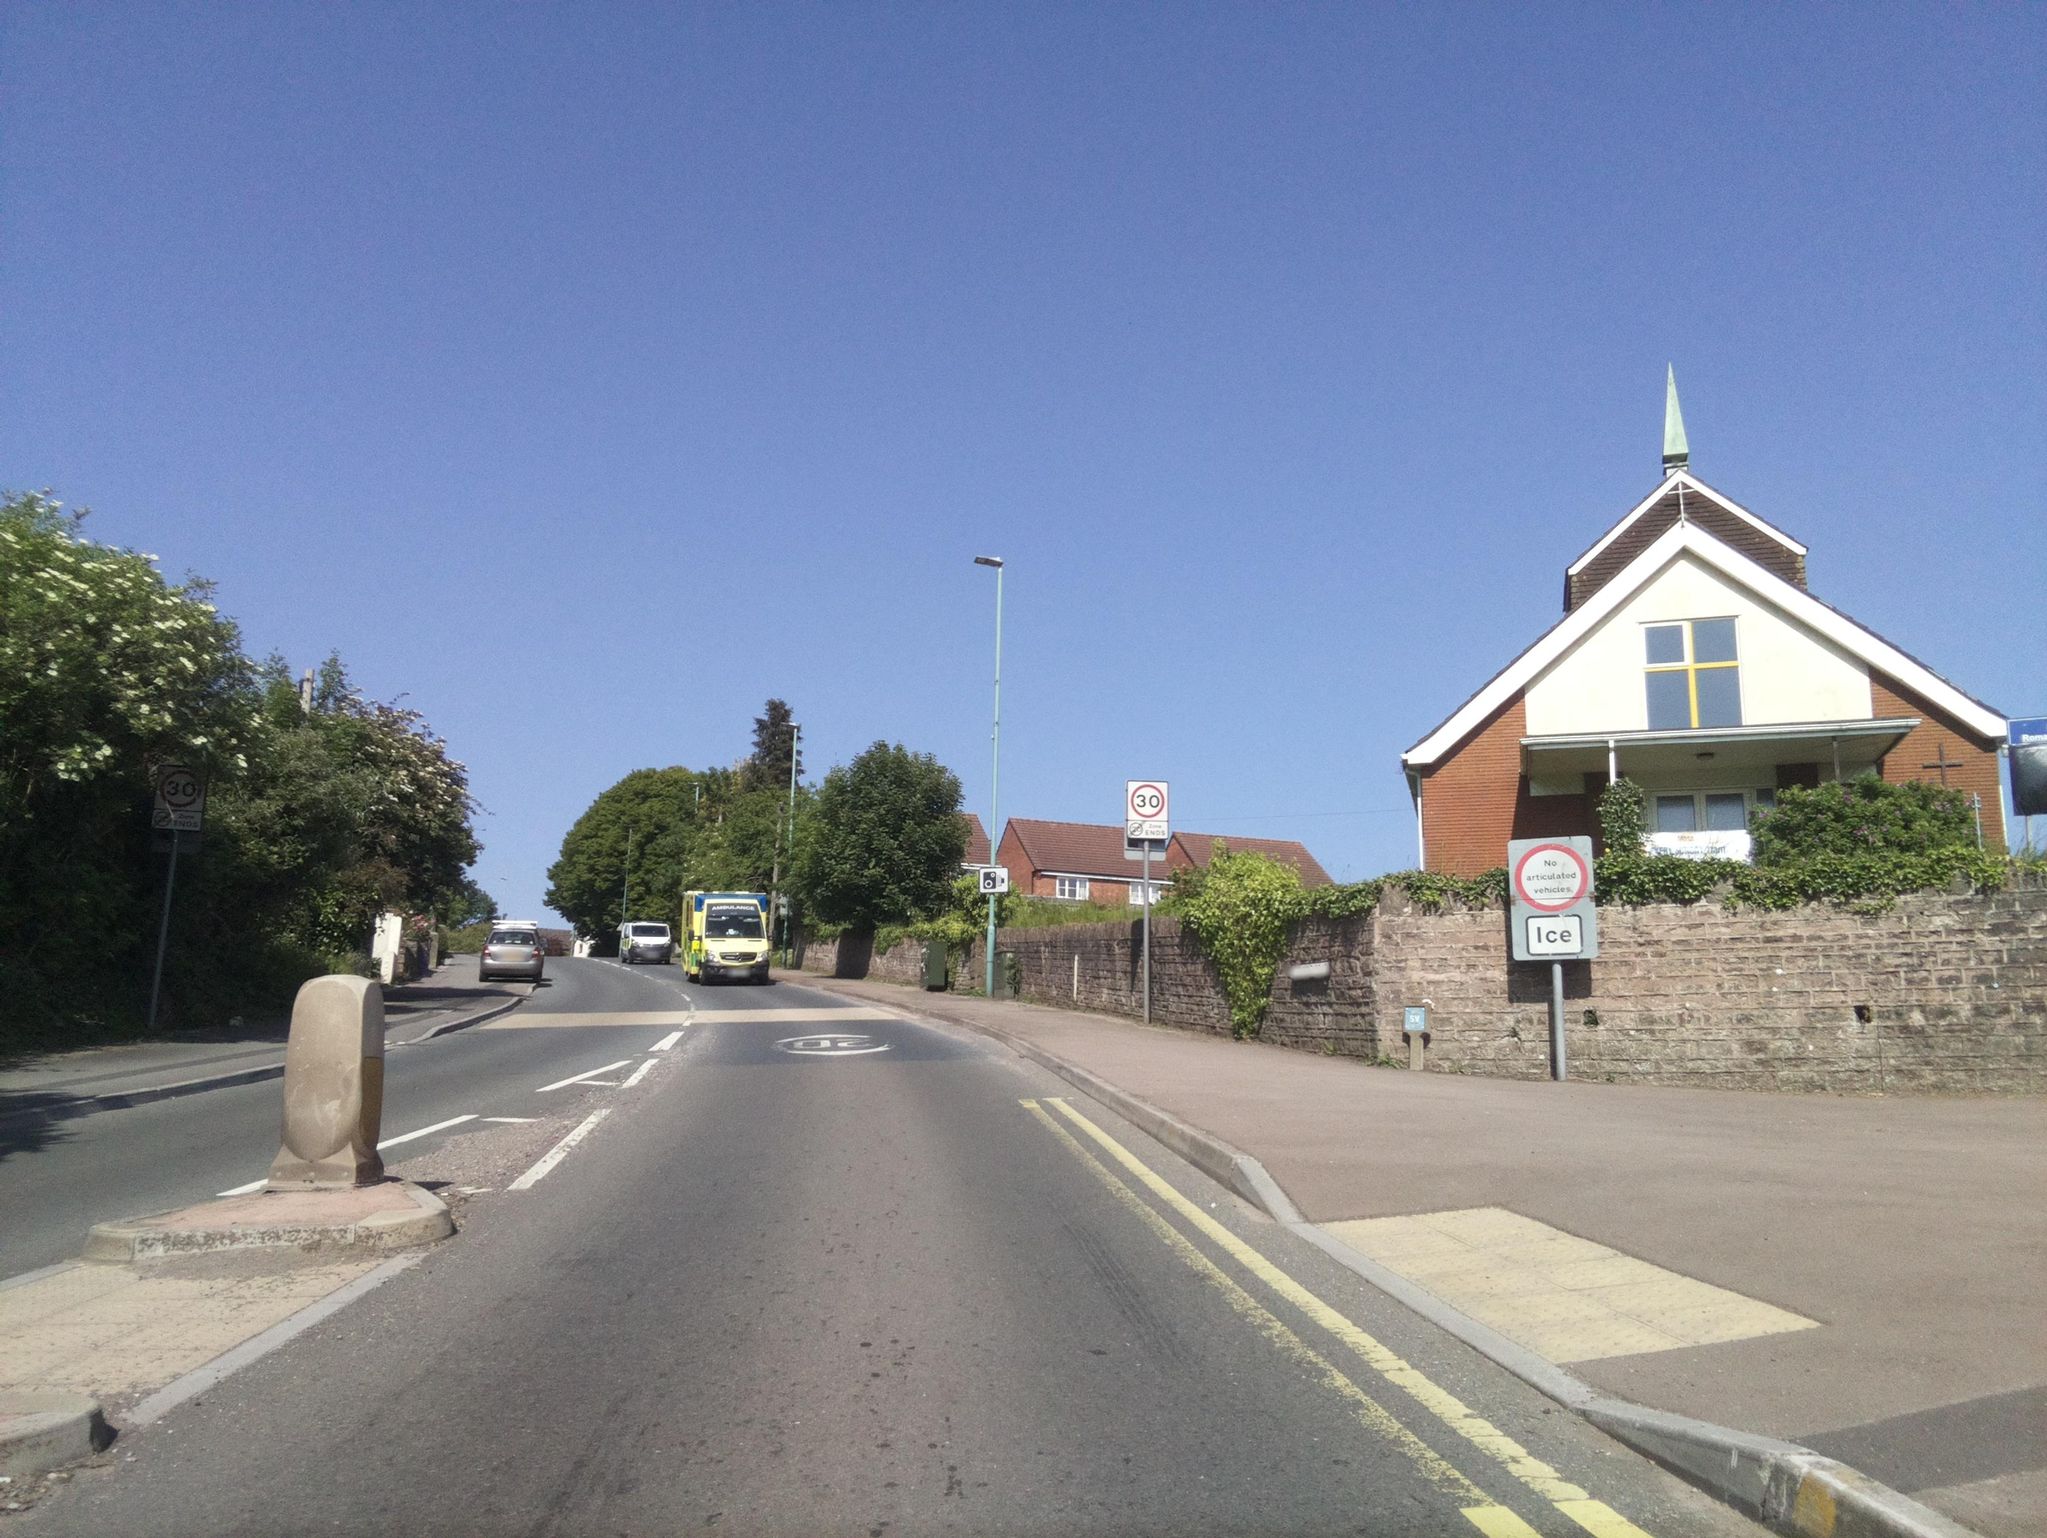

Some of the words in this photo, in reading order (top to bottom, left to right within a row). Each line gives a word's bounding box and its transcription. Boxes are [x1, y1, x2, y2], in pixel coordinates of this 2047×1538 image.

[166, 781, 196, 797] 30
[1136, 794, 1160, 808] 30
[1526, 872, 1577, 881] articulated
[1534, 886, 1572, 894] vehicles
[1536, 926, 1572, 943] Ice
